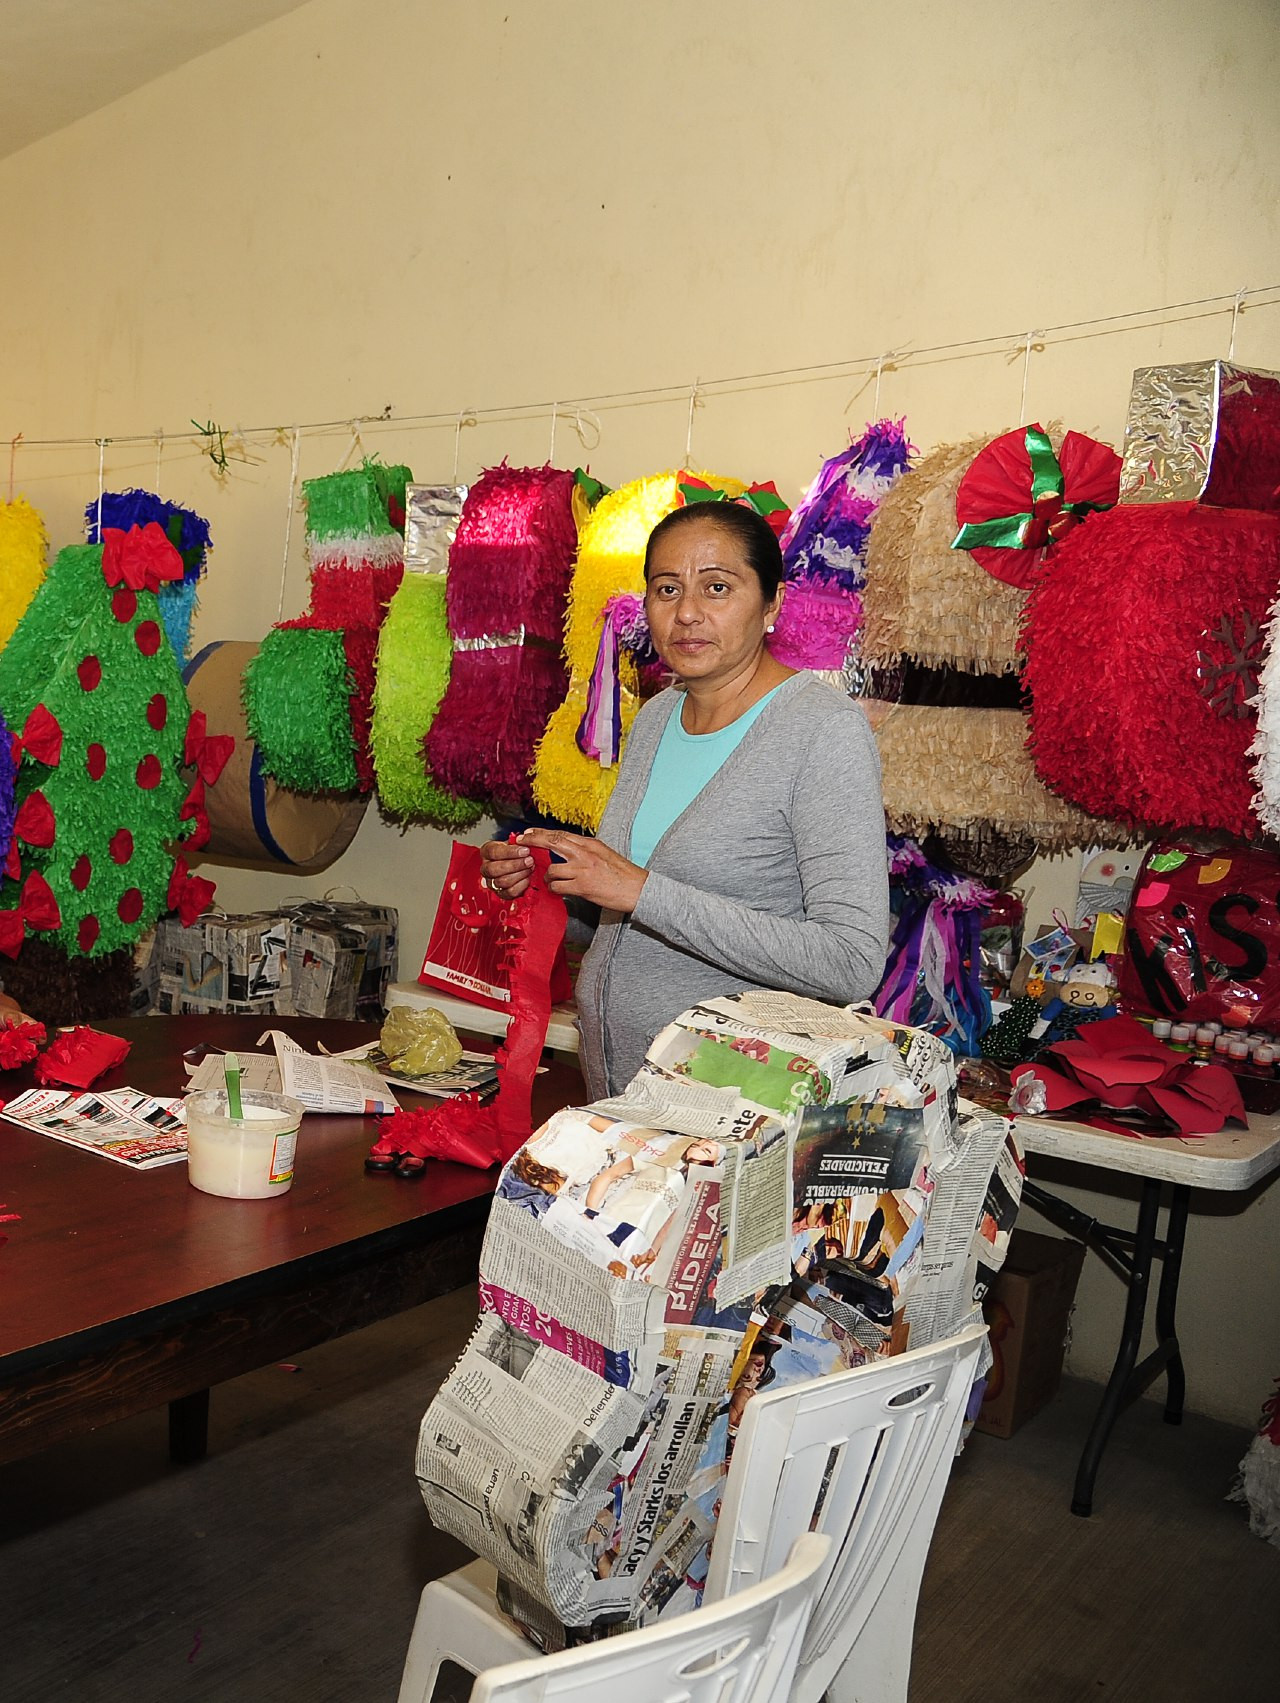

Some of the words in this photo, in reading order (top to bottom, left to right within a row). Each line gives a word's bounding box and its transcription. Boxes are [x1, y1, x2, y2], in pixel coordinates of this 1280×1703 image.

[446, 971, 467, 985] FAMILY
[820, 1160, 890, 1174] FELICIDADES
[668, 1245, 687, 1289] SUSCRIPTOR
[687, 1220, 698, 1235] EL
[694, 1184, 711, 1220] NORTE
[692, 1278, 703, 1300] COSTO
[666, 1401, 697, 1461] arrollan
[654, 1460, 672, 1486] los
[636, 1484, 664, 1535] Starks
[635, 1535, 650, 1548] y
